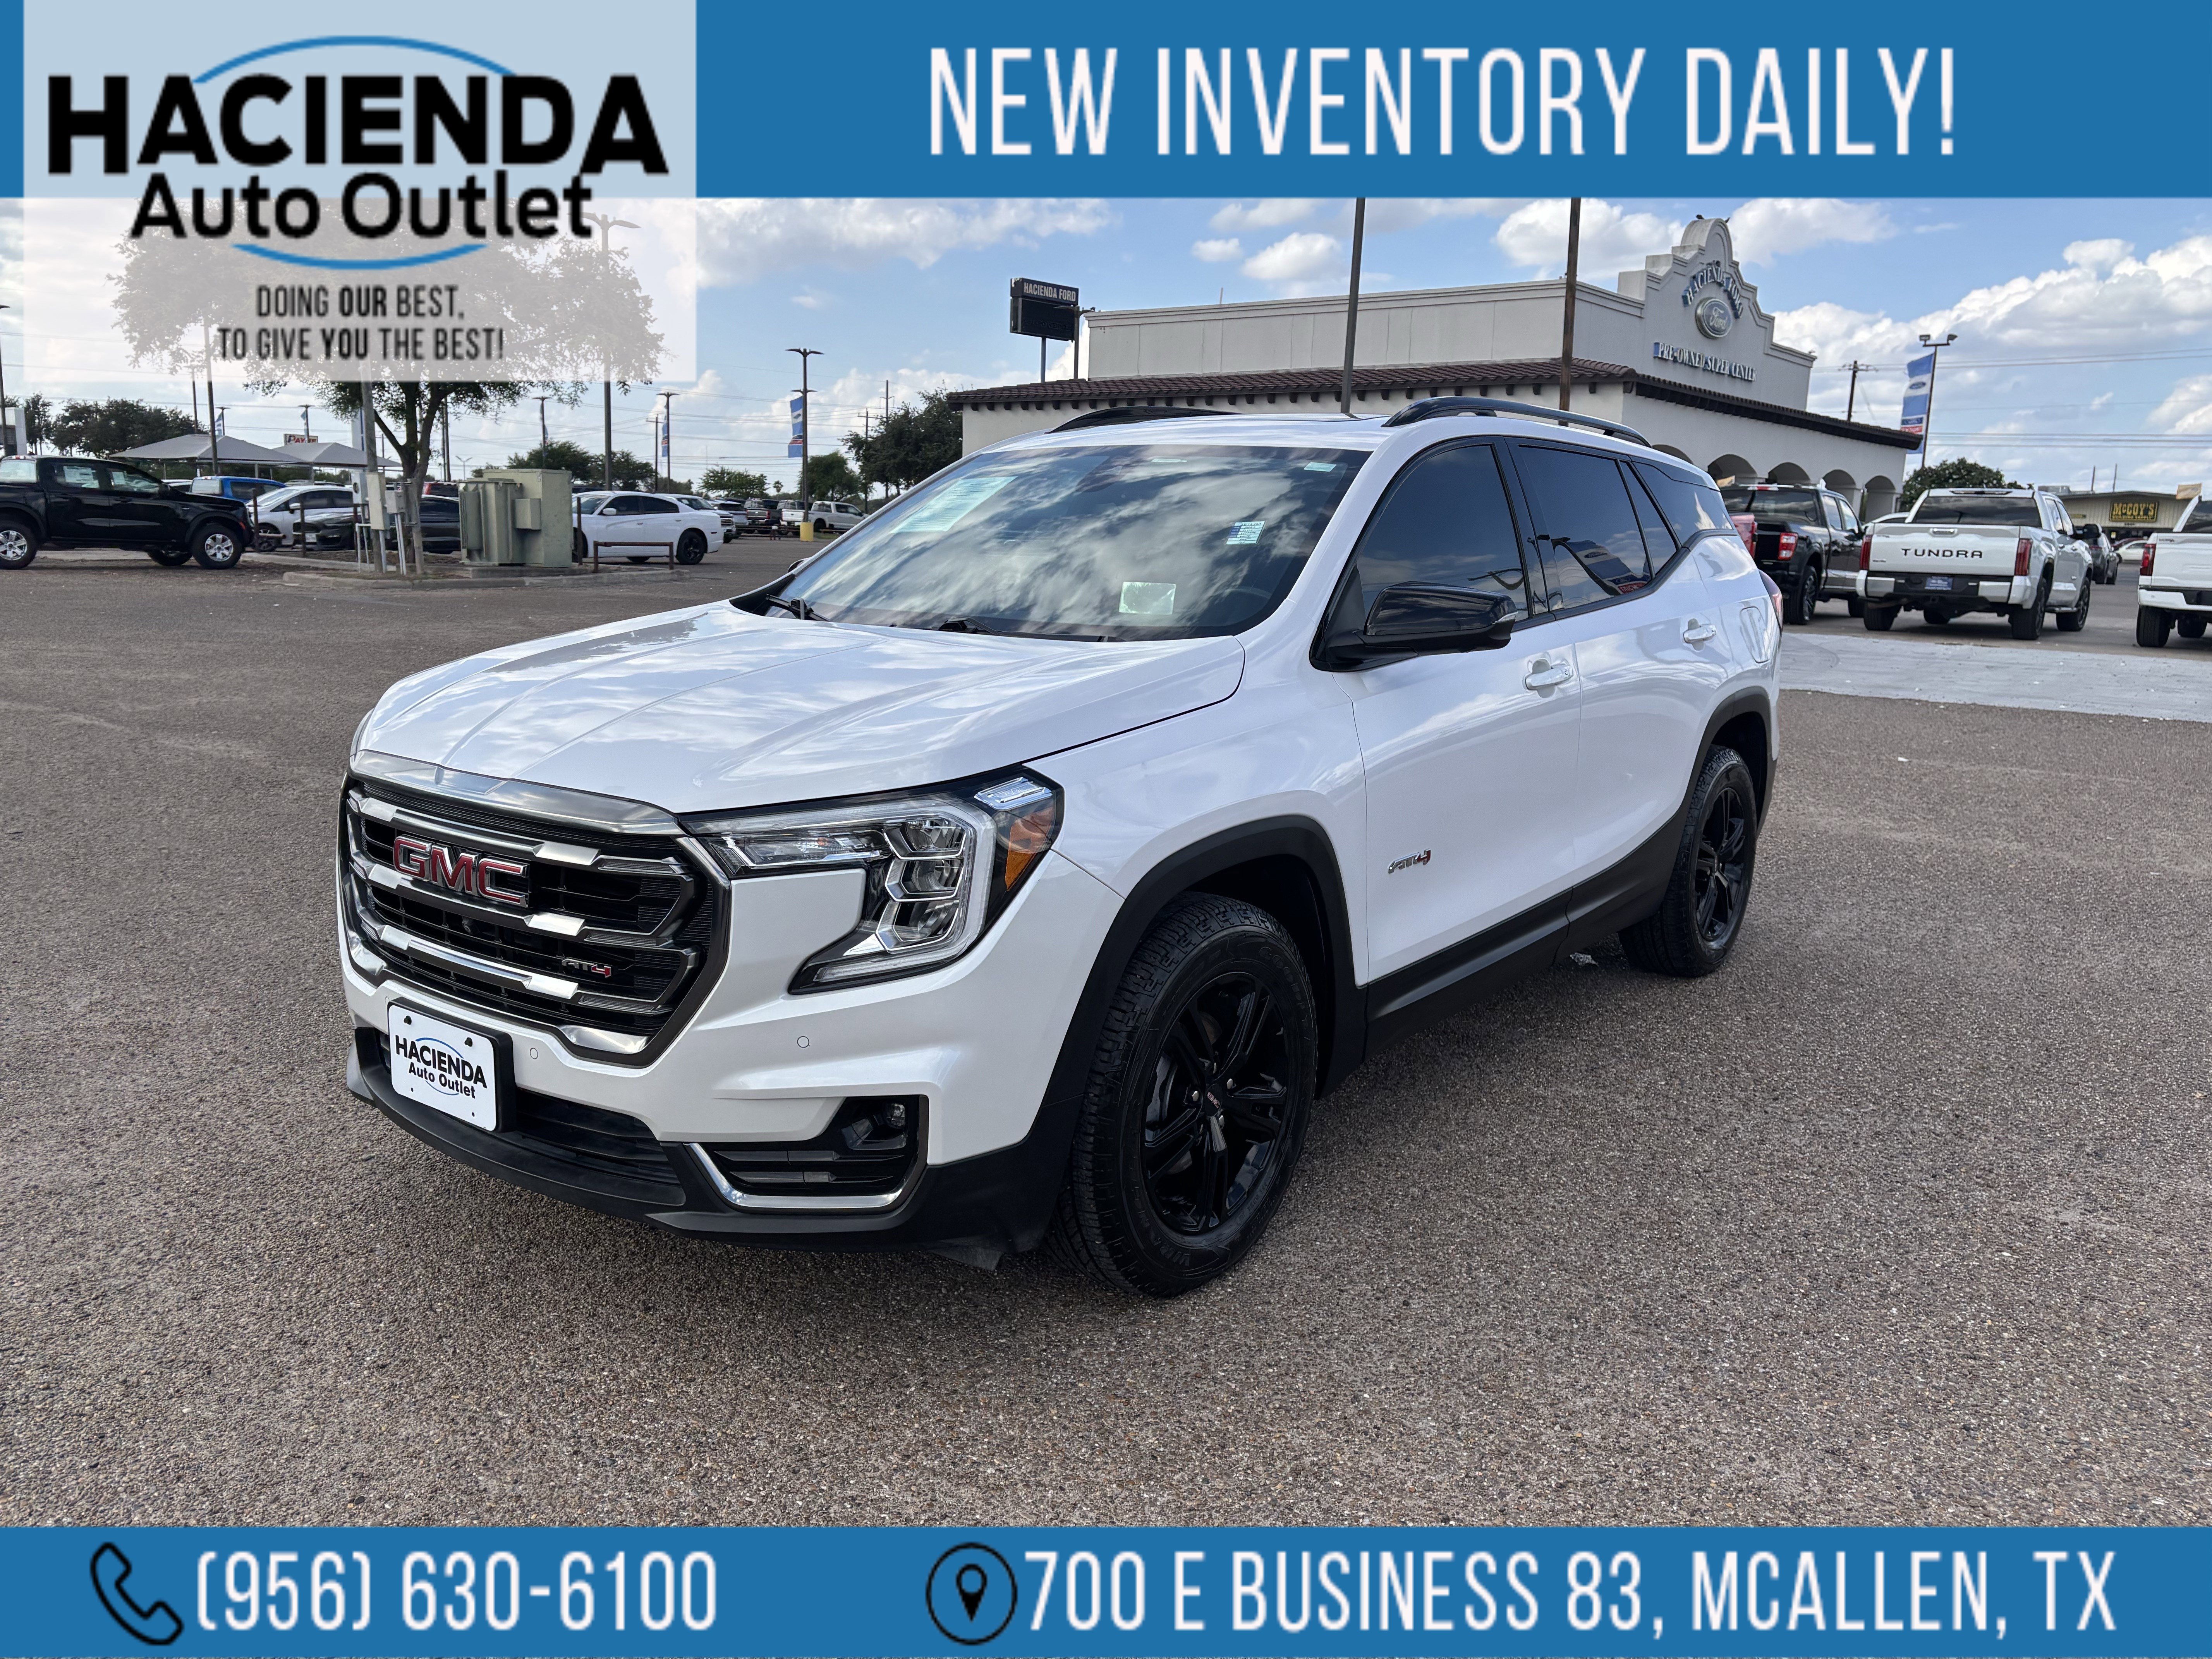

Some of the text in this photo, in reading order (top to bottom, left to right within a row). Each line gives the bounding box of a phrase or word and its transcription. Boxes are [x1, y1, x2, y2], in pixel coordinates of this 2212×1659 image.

[1024, 282, 1076, 302] HACIENDA FORD
[1709, 307, 1728, 330] Ford
[1655, 342, 1757, 381] PRE-OWNED SUPER CENTER
[287, 434, 317, 443] PAYE
[1901, 548, 1983, 558] TUNDRA
[393, 834, 530, 908] GMC
[1387, 848, 1431, 874] AT4
[561, 957, 612, 978] AT4
[395, 1034, 488, 1089] HACIENDA
[408, 1062, 476, 1099] Auto Outlet
